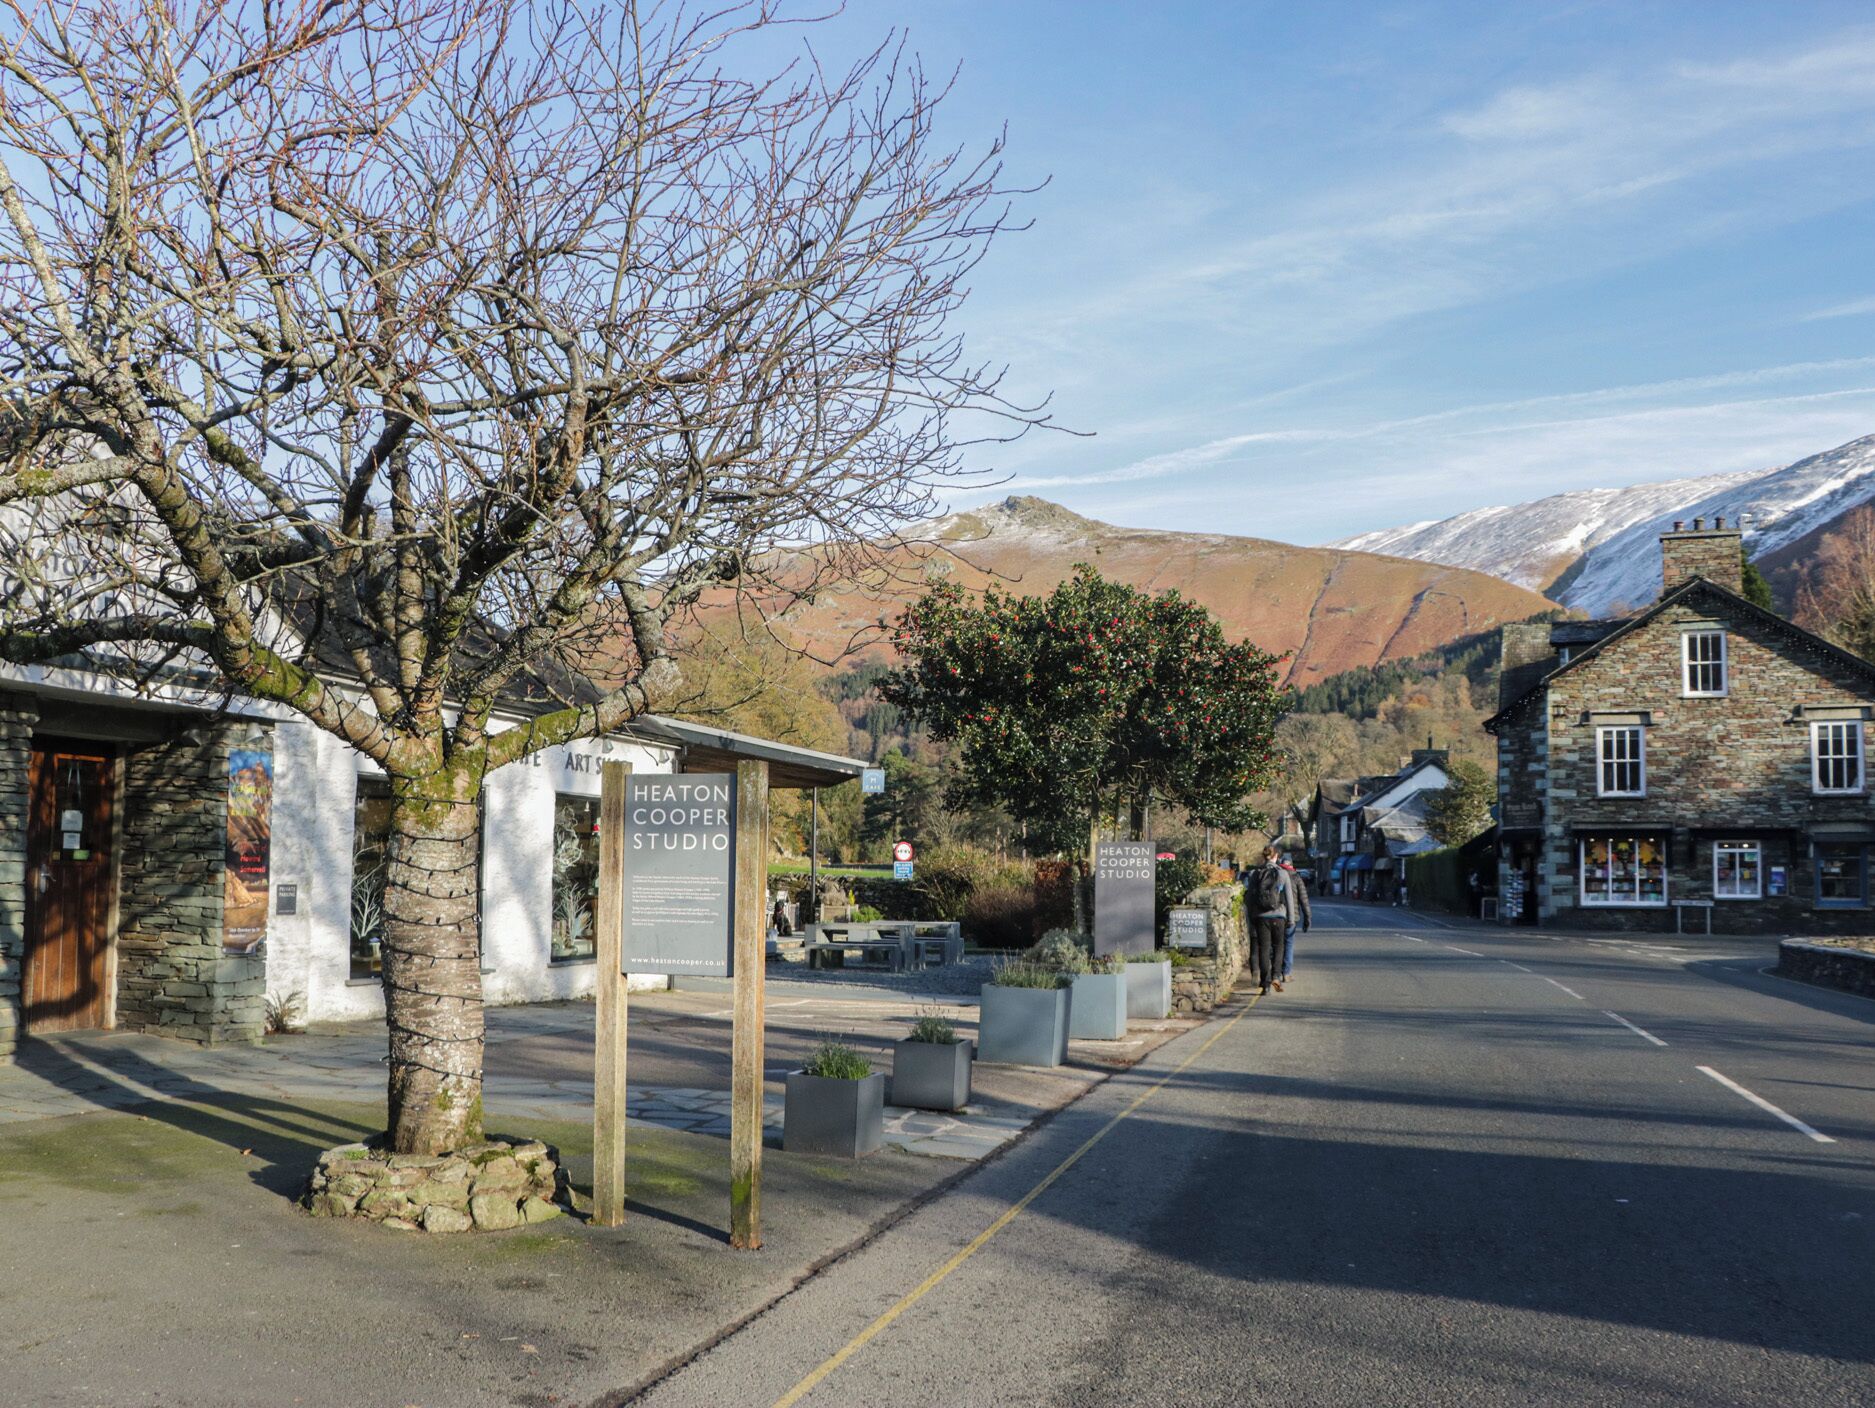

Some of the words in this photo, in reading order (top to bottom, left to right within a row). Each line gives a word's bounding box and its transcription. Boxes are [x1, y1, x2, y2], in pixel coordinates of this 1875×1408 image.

[565, 751, 593, 773] ART
[634, 785, 729, 802] HEATON
[633, 808, 729, 826] COOPER
[633, 833, 729, 850] STUDIO
[1100, 847, 1150, 856] HEATON
[1100, 858, 1150, 867] COOPER
[1100, 869, 1150, 879] STUDIO
[630, 956, 726, 967] www.heatoncooper.co.uk
